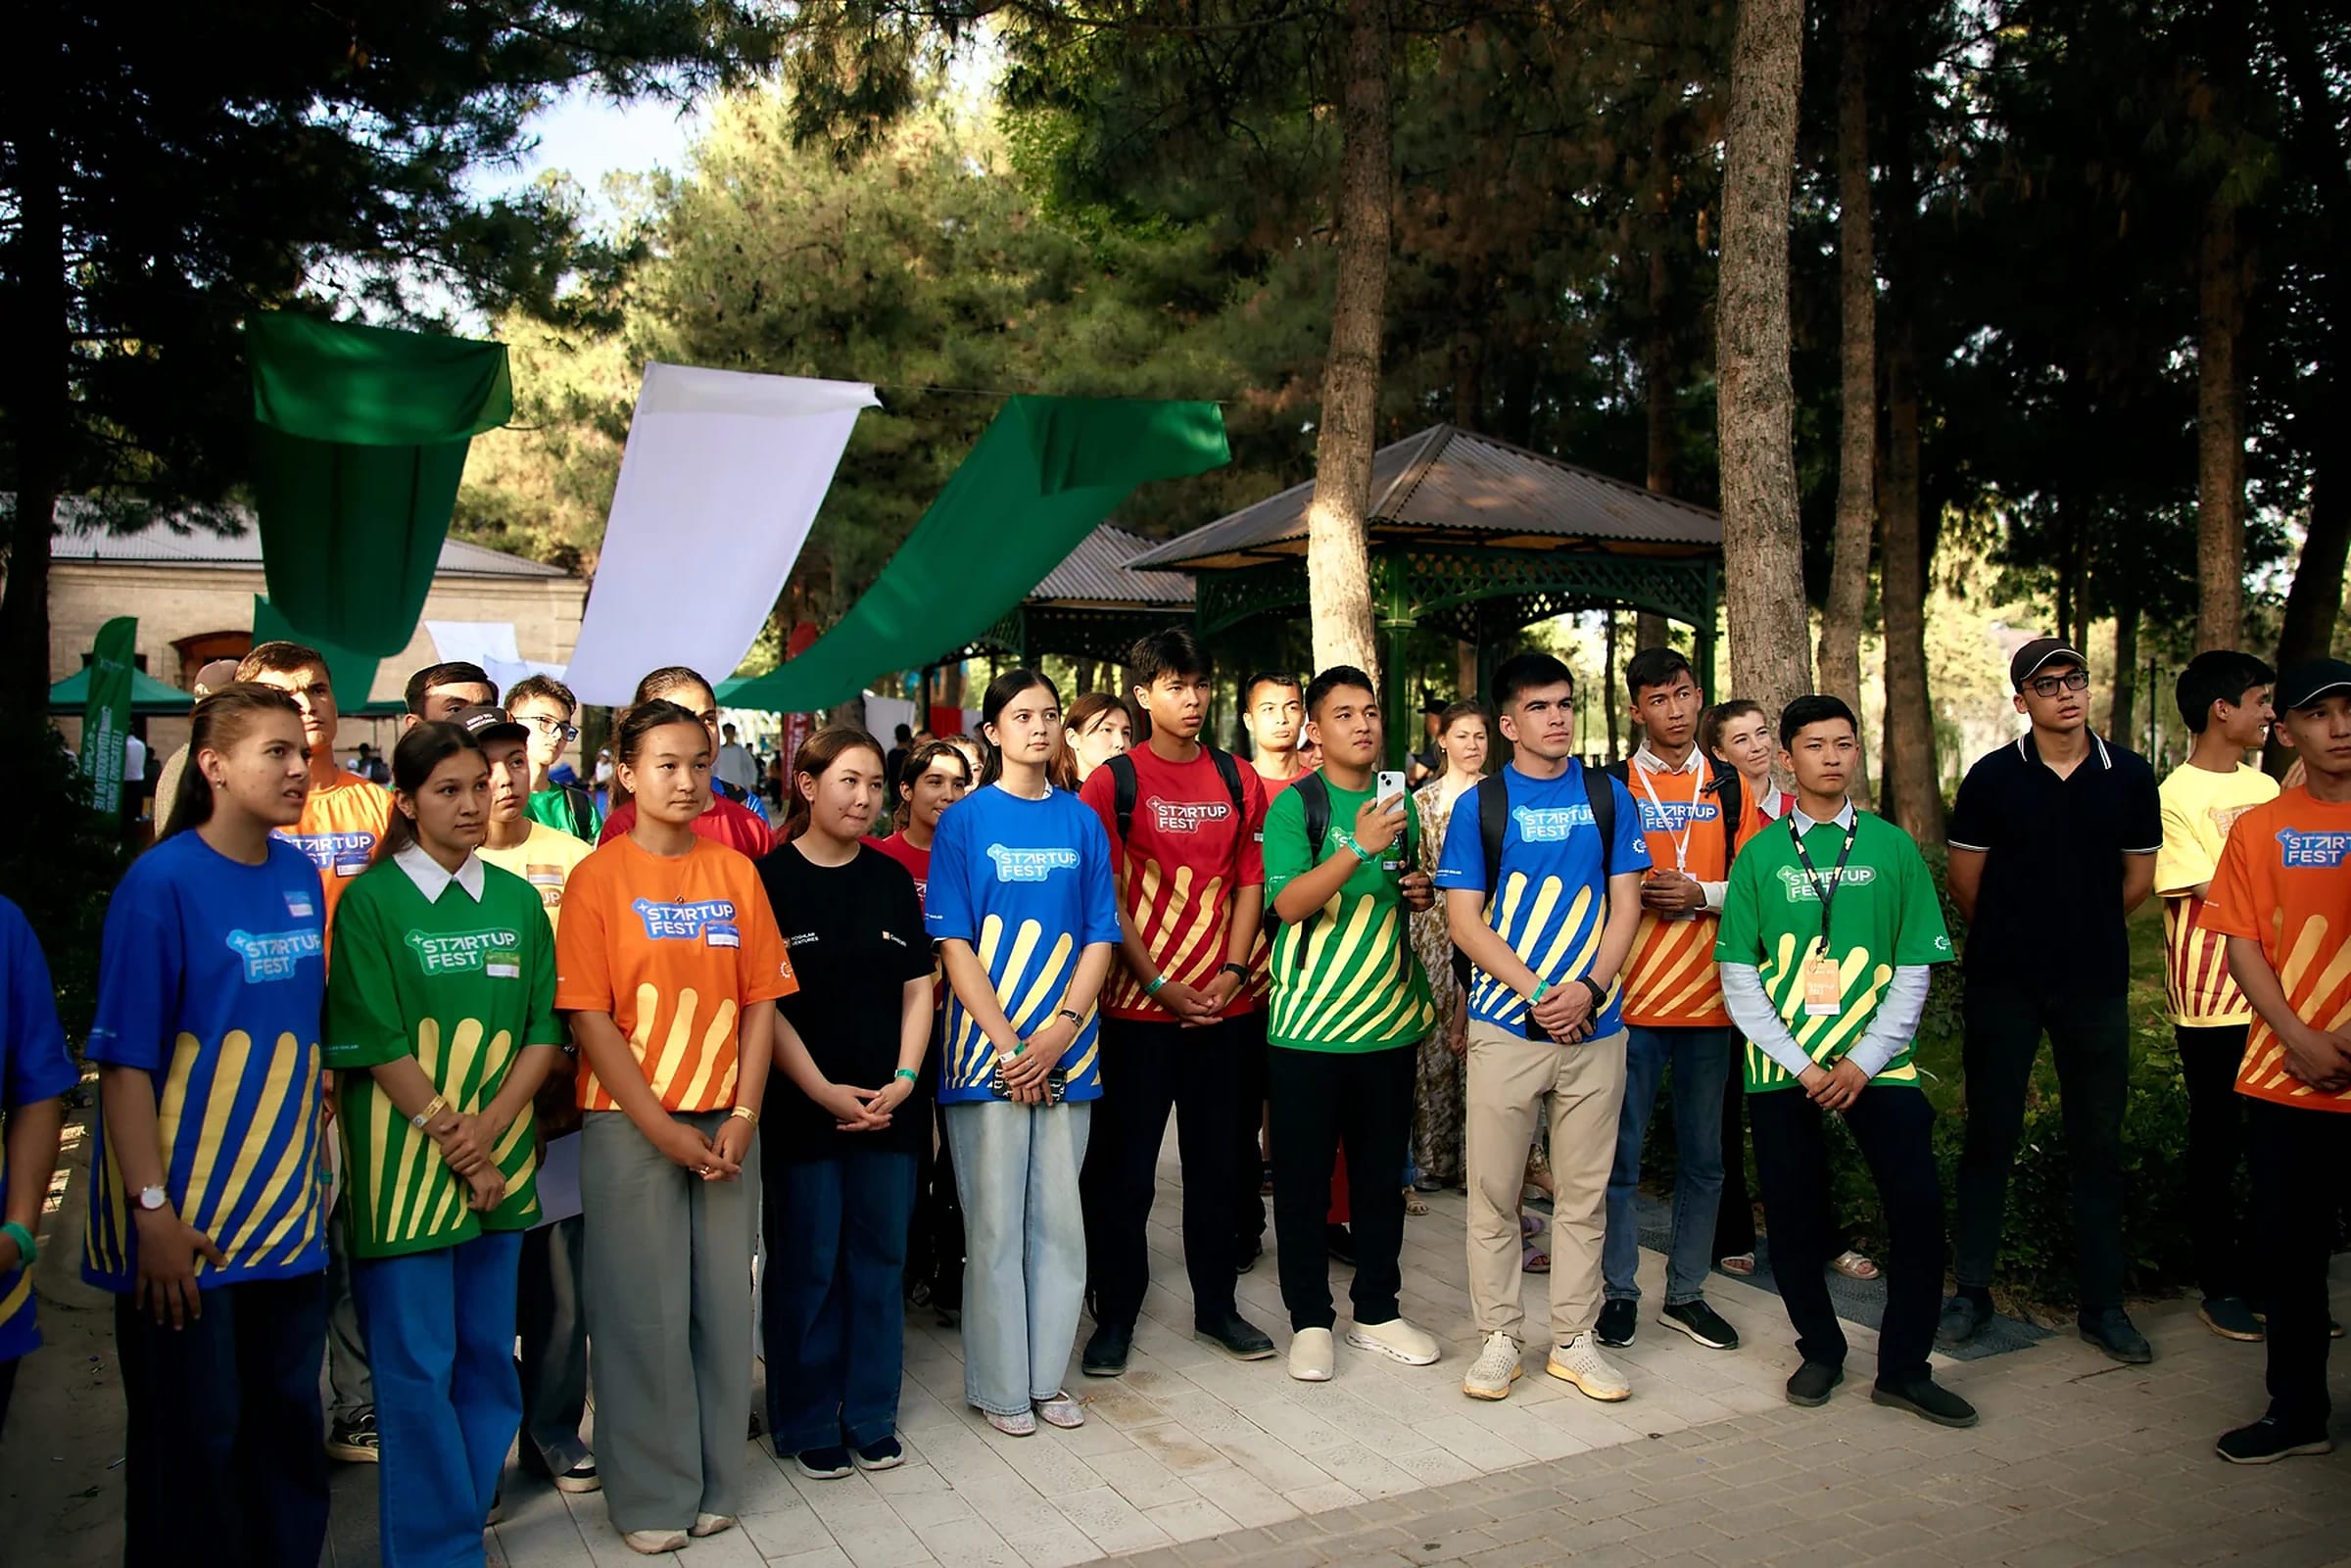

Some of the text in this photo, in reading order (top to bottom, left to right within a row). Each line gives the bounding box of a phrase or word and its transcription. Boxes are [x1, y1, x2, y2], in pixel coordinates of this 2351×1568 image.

[1158, 805, 1226, 817] STARTUP
[1159, 817, 1195, 830] FEST
[1526, 825, 1567, 837] FEST
[285, 835, 372, 851] TARTUP
[1000, 852, 1078, 865] STARTUP
[2288, 850, 2340, 863] FEST
[1002, 865, 1044, 878] FEST
[648, 904, 734, 921] STARTUP
[650, 922, 696, 935] FEST
[422, 932, 515, 954] STARTUP
[251, 957, 290, 977] FEST
[427, 951, 477, 970] FEST
